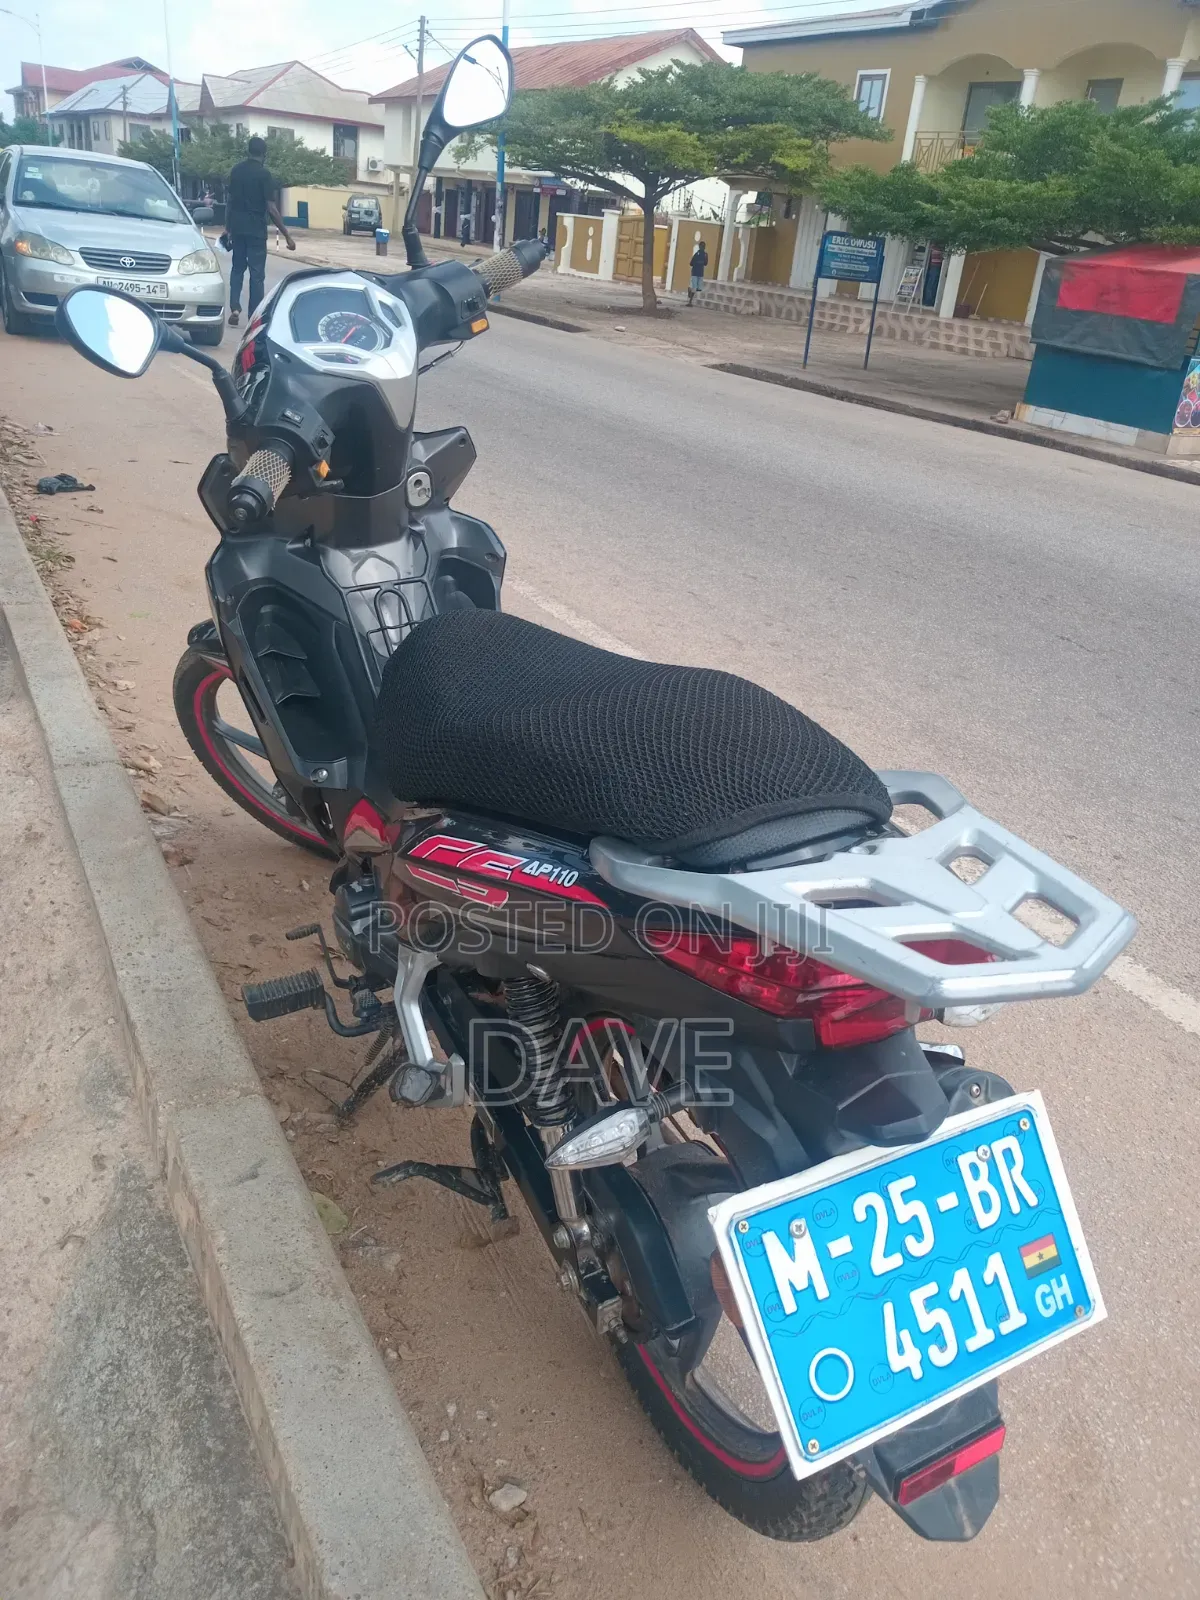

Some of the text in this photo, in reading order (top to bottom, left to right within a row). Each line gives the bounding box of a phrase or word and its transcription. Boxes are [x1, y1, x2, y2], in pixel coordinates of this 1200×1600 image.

[831, 235, 877, 249] ERIC OWUSU
[521, 860, 579, 888] AP110
[763, 1136, 1039, 1316] M-25-BR
[884, 1252, 1028, 1381] 4511
[1034, 1273, 1074, 1318] GH
